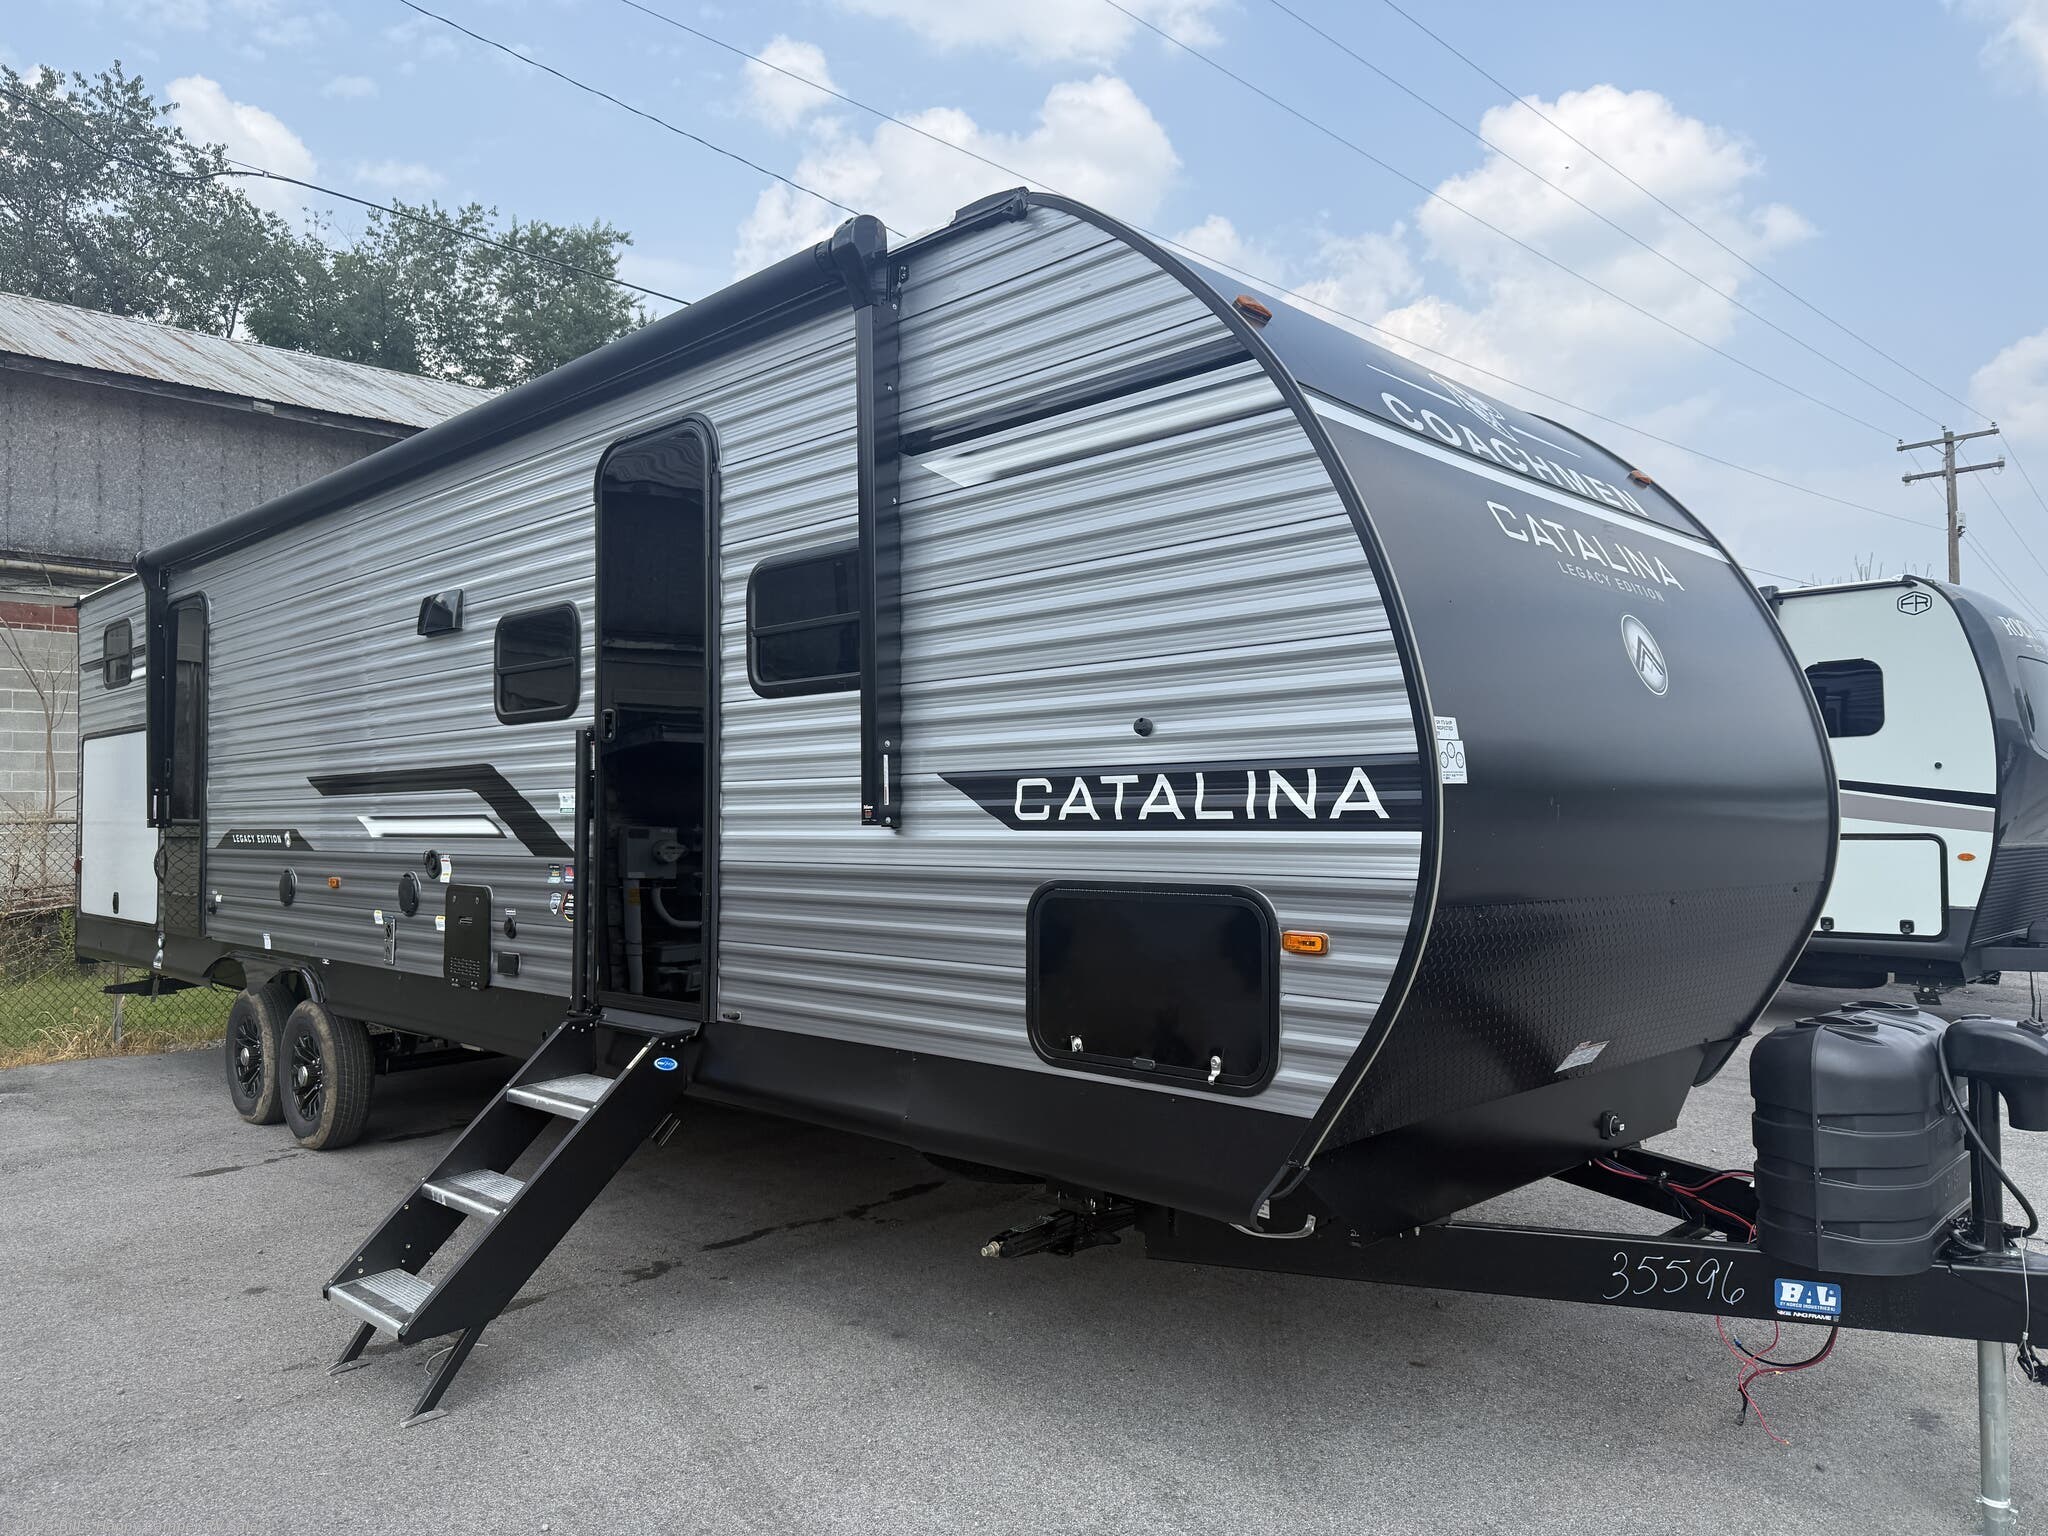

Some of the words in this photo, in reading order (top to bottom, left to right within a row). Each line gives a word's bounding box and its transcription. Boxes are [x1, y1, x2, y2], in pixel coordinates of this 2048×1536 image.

[1381, 392, 1648, 517] COACHMEN
[1486, 501, 1686, 592] CATALINA
[1557, 561, 1612, 587] LEGACY
[1614, 578, 1665, 602] EDITION
[1013, 766, 1391, 822] CATALINA
[232, 834, 255, 844] LEGACY
[256, 834, 282, 844] EDITION
[1602, 1251, 1745, 1306] 35596
[1780, 1282, 1836, 1306] BAL
